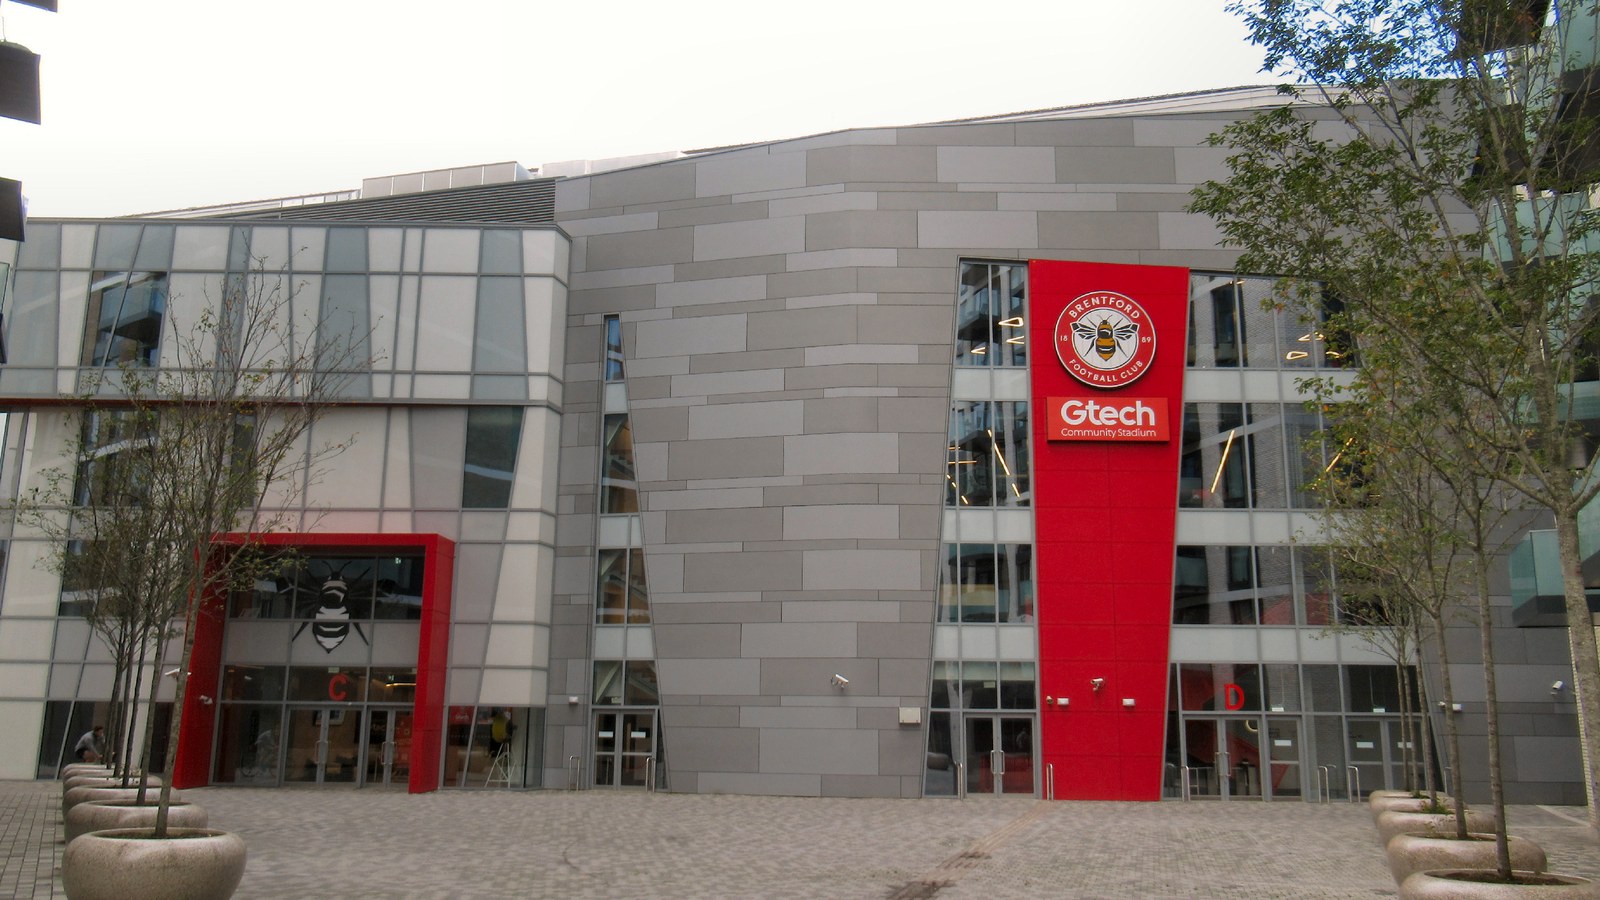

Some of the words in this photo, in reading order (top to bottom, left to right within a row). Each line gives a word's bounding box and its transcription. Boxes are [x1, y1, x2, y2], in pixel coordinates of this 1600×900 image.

[1068, 296, 1140, 319] BRENTFORD
[1069, 359, 1118, 382] FOOTBALL
[1120, 360, 1143, 379] CLUB
[1060, 400, 1155, 426] Gtech
[1061, 428, 1116, 438] Community
[1118, 428, 1156, 437] Stadium
[329, 674, 347, 701] C
[1224, 684, 1245, 711] D
